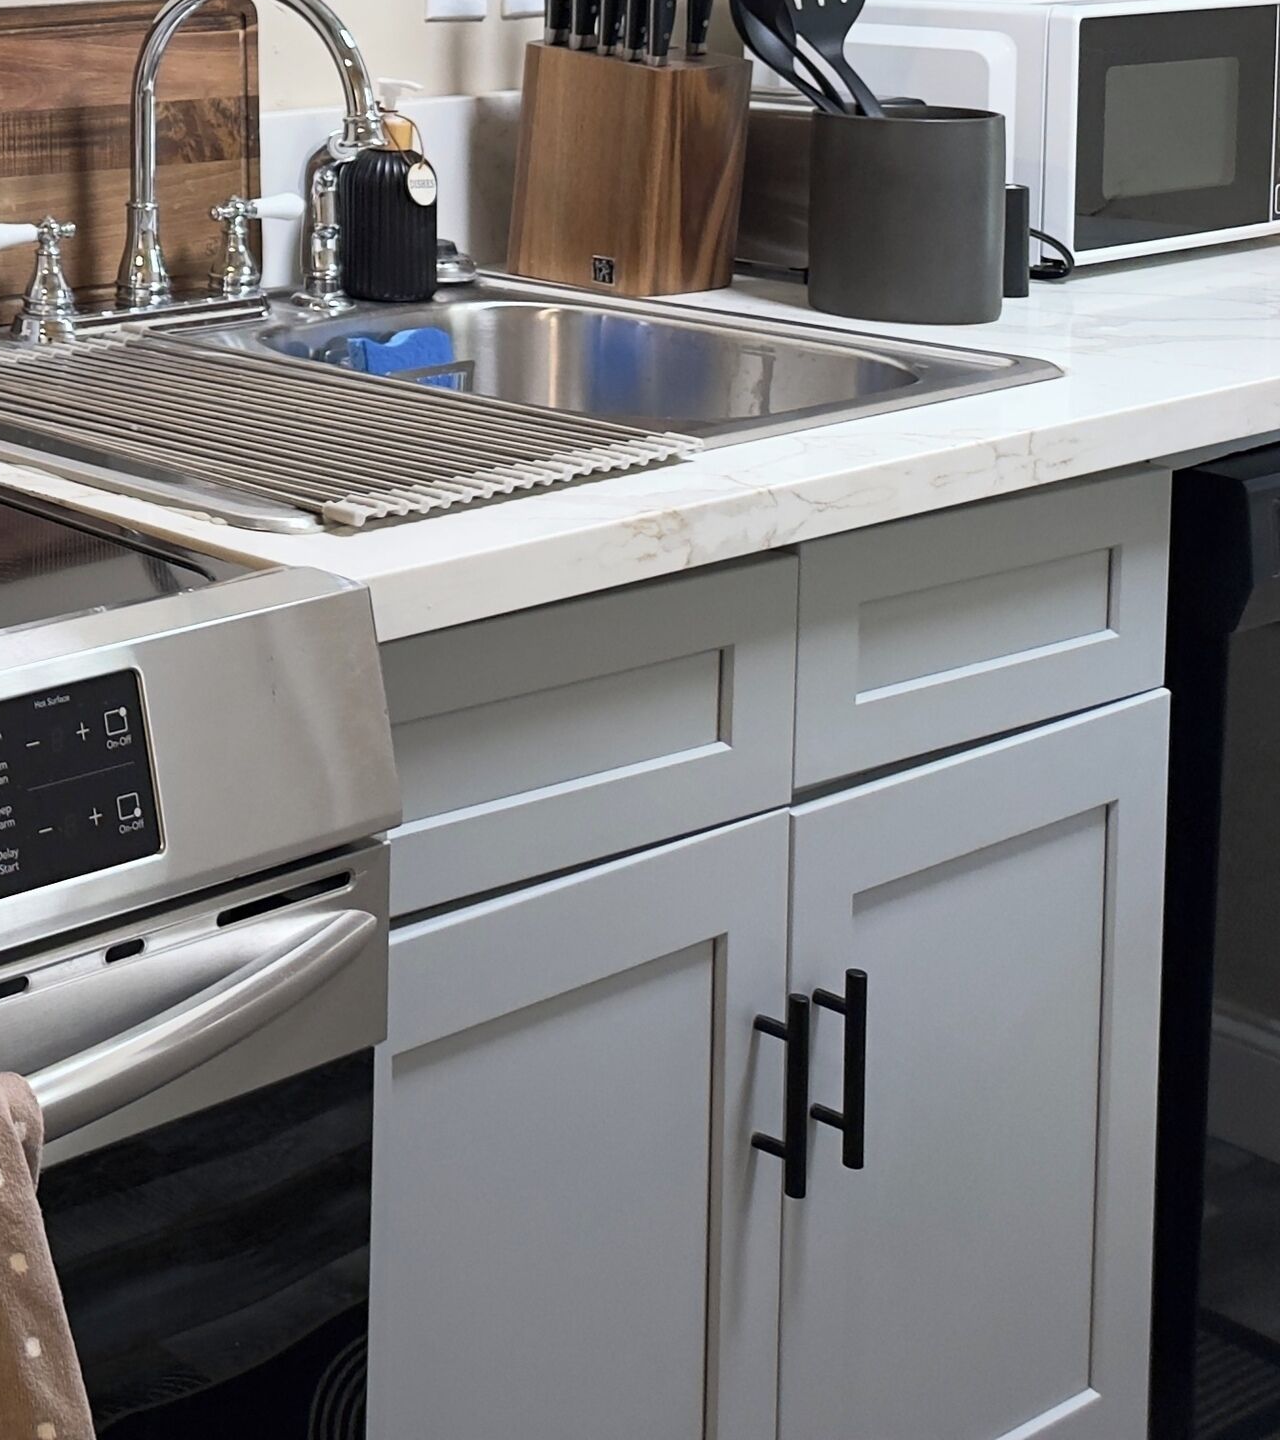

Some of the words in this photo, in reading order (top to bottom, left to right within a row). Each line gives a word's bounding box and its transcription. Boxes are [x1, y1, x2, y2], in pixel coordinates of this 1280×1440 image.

[34, 699, 46, 709] Hot
[47, 695, 71, 707] Surface
[106, 734, 132, 750] On-Off
[118, 818, 145, 835] On-Off
